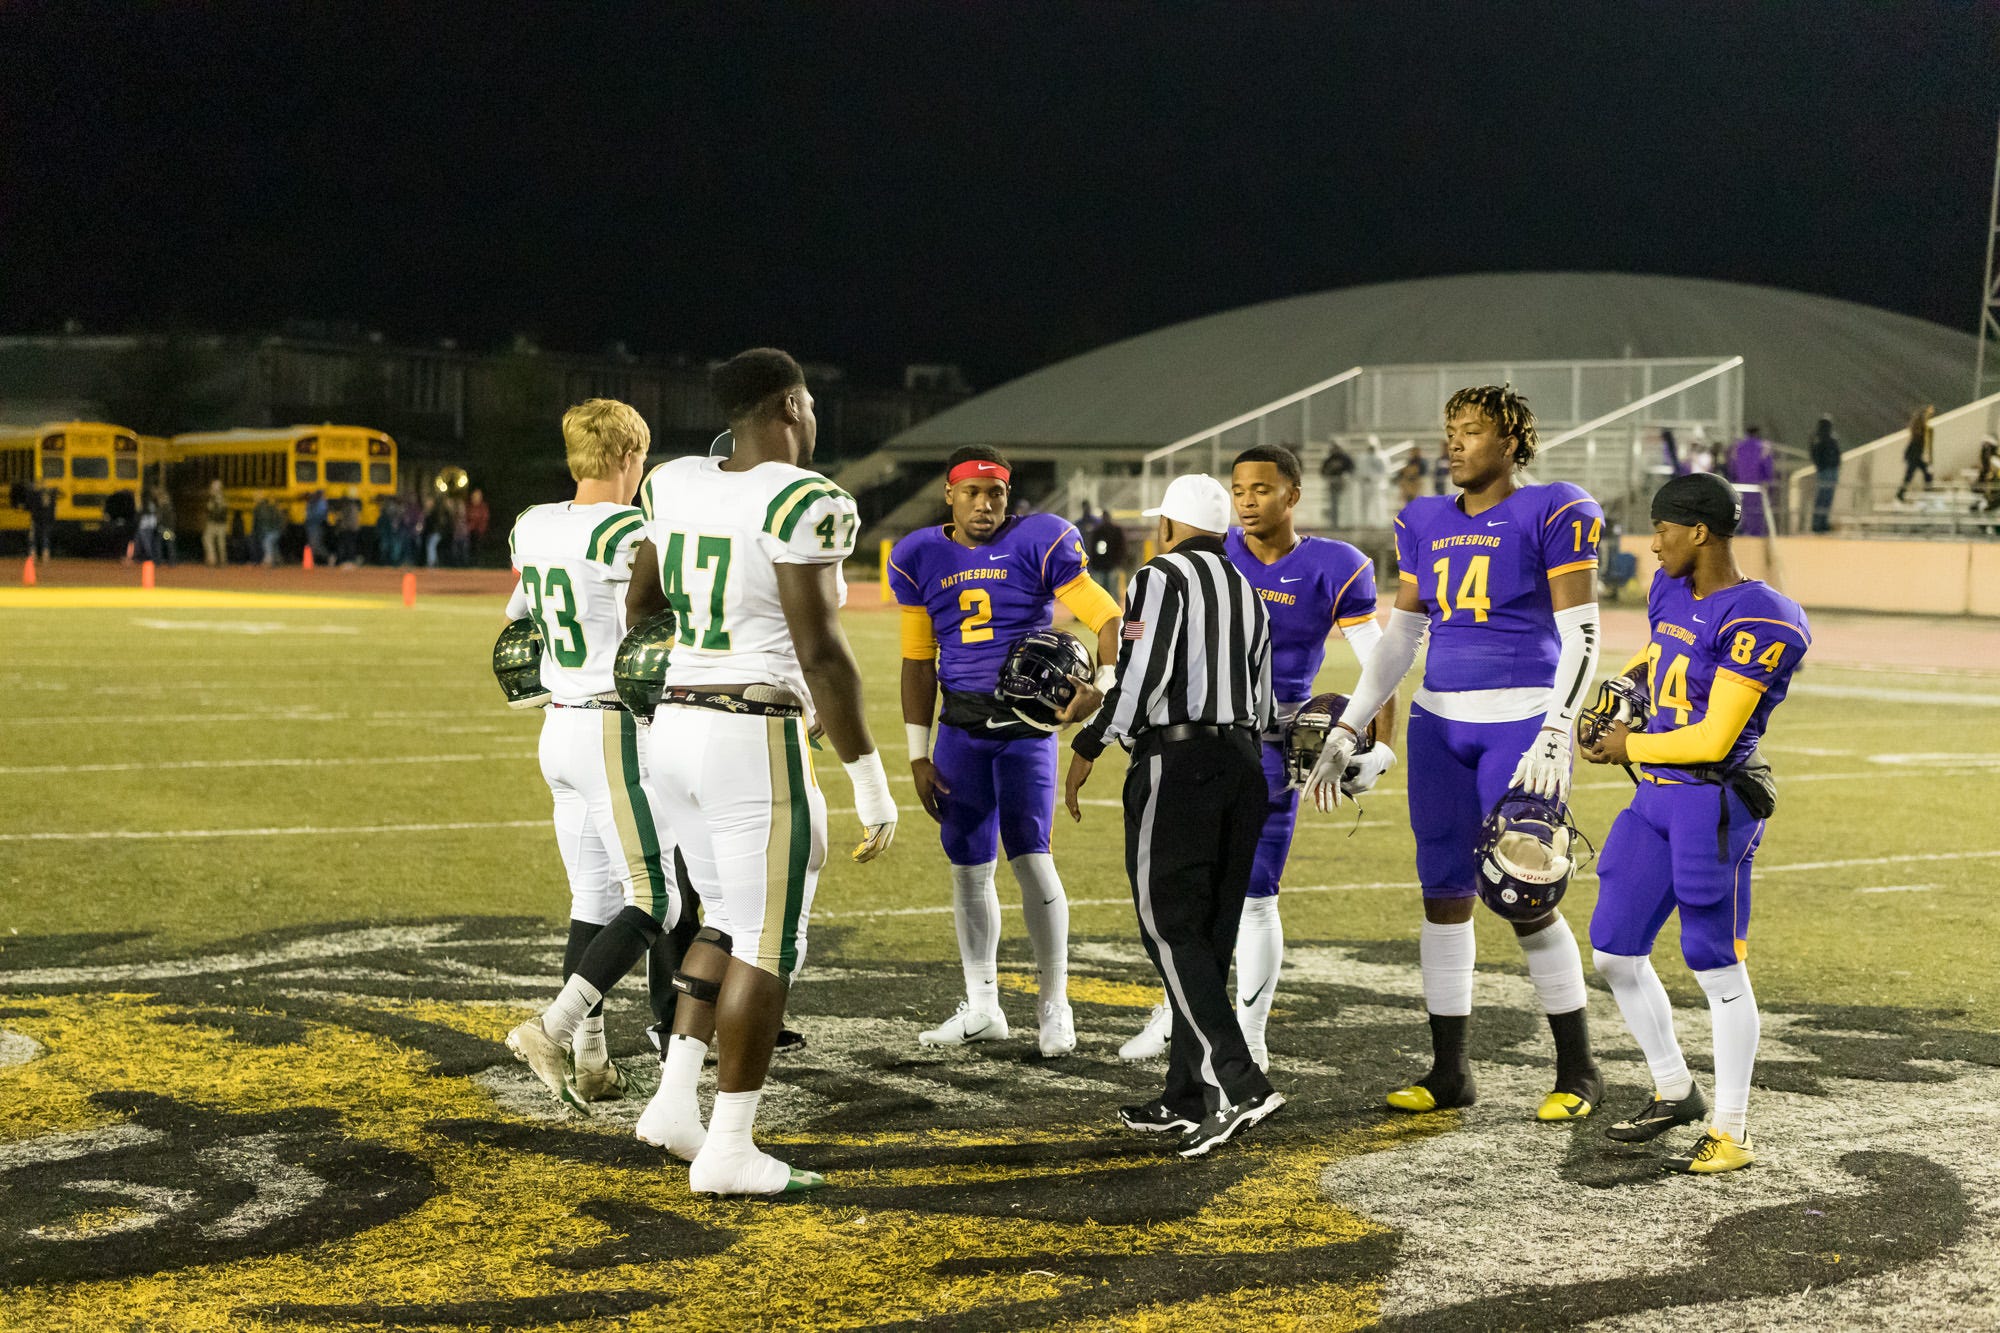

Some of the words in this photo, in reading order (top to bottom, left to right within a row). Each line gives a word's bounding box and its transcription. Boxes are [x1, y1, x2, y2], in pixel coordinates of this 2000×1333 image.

[814, 511, 856, 549] 47
[1431, 534, 1501, 551] HATTIESBURG
[1571, 517, 1601, 552] 14
[663, 530, 732, 652] 47
[940, 569, 1008, 589] HATTIESBURG
[1432, 555, 1491, 622] 14
[958, 588, 994, 643] 2
[1656, 621, 1697, 646] HATTIESBURG
[1730, 630, 1787, 673] 84
